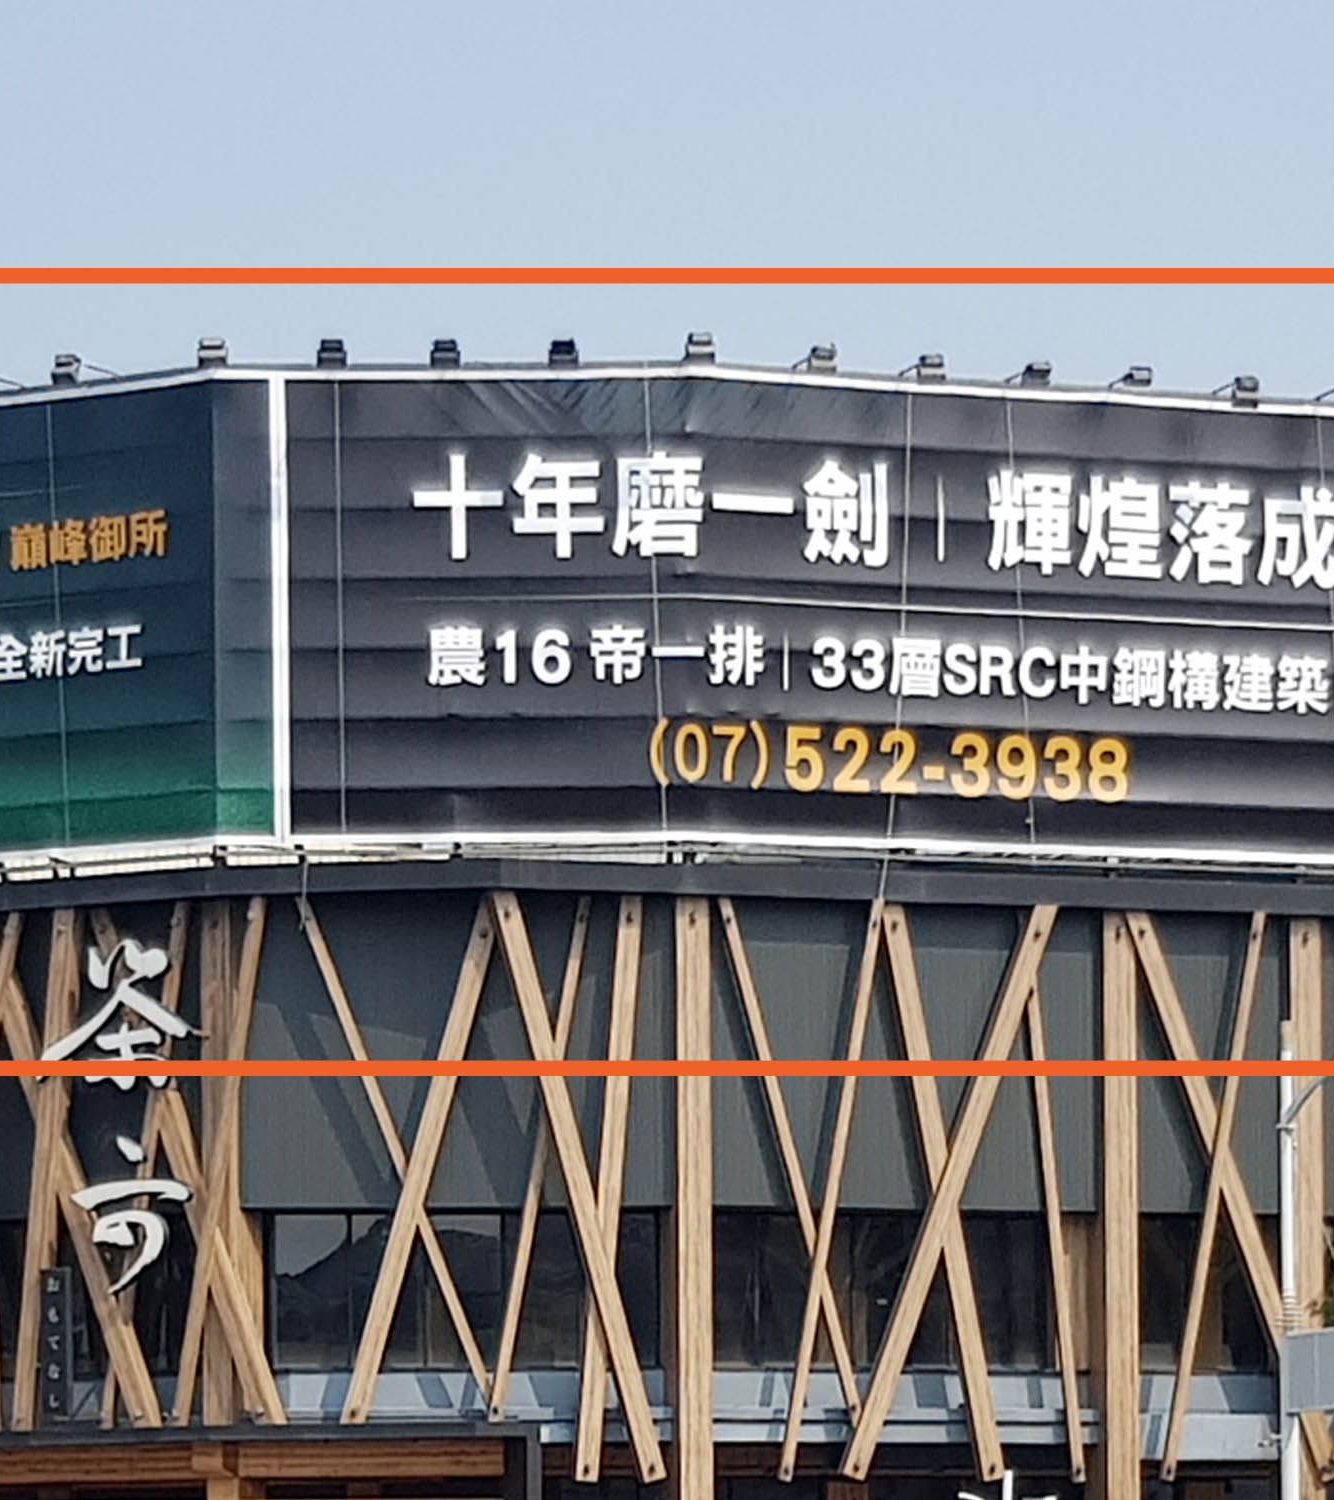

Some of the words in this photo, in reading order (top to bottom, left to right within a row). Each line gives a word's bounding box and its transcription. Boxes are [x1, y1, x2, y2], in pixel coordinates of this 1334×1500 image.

[412, 450, 889, 568] 十年磨一劍
[427, 626, 573, 686] 農16
[590, 624, 766, 686] 帝一排
[811, 636, 1331, 714] 33層SRC中鋼構建築
[648, 717, 1130, 803] (07)522-3938
